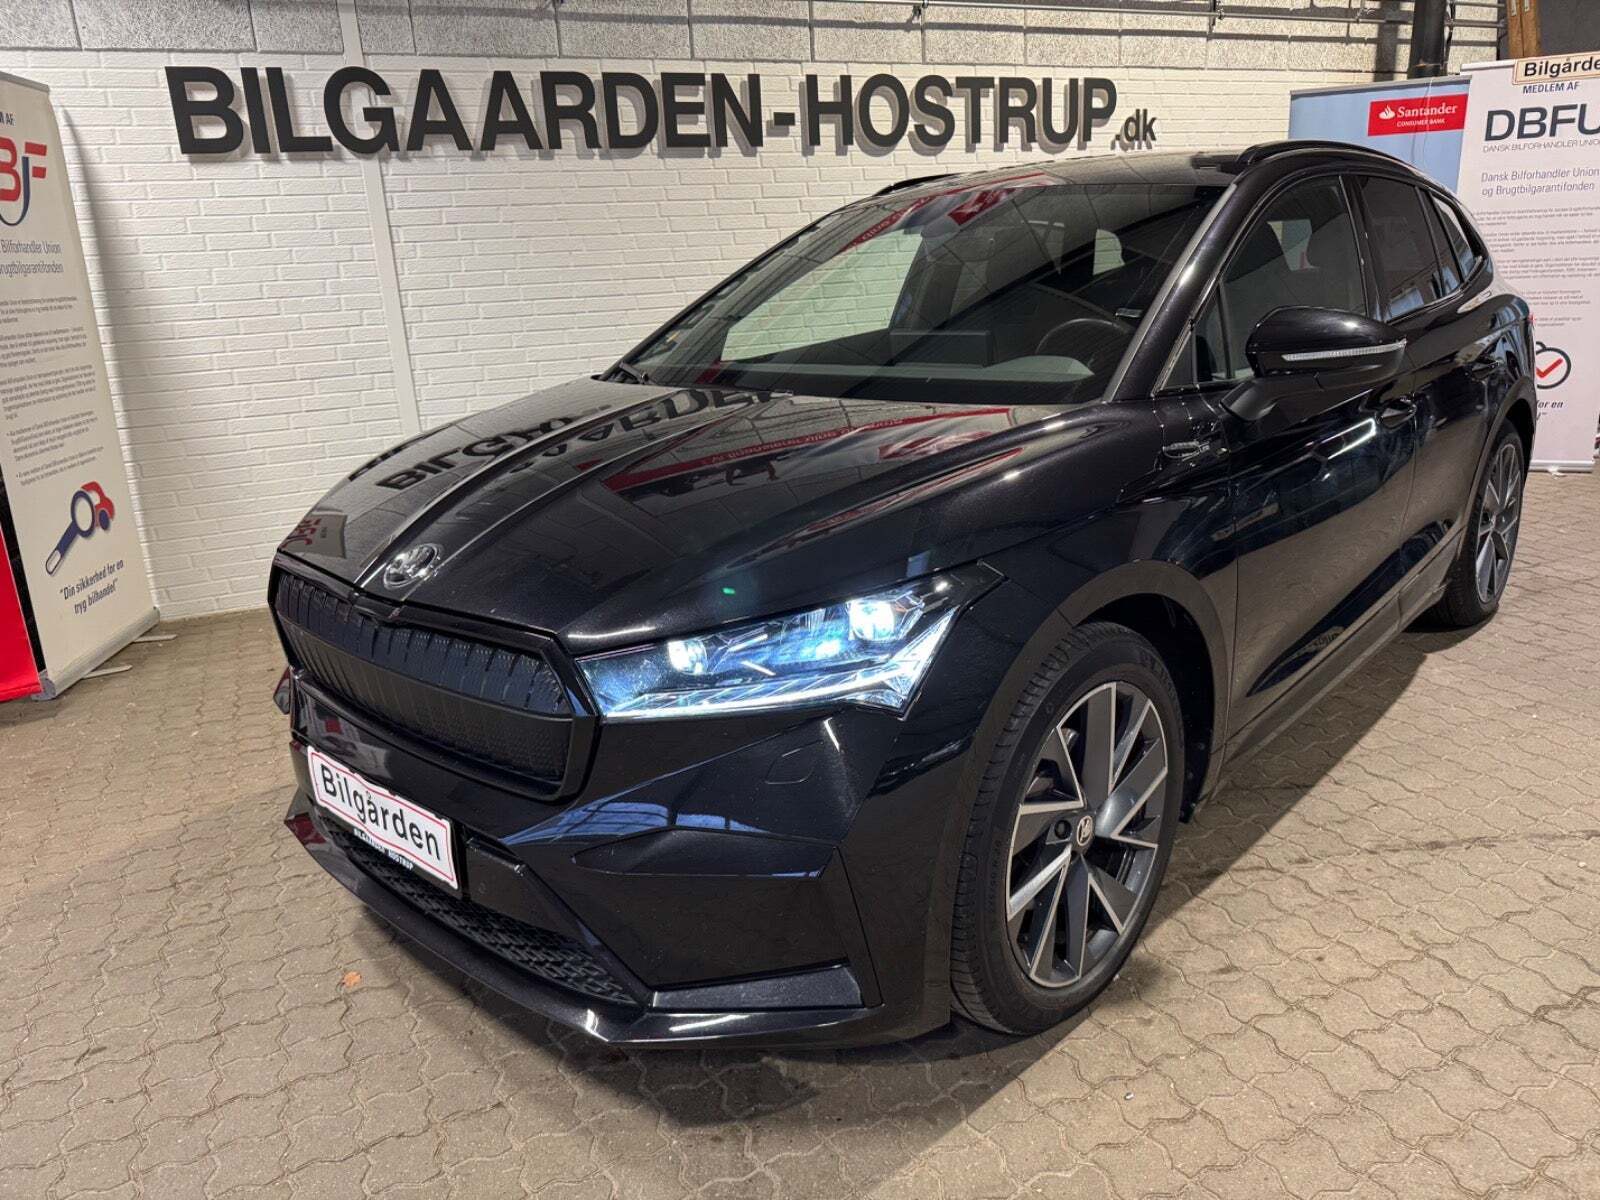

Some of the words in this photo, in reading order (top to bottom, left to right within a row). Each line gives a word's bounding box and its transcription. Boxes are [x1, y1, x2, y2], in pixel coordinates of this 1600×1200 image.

[1523, 83, 1566, 94] MEDLEM
[1567, 81, 1580, 92] AF
[1397, 102, 1458, 118] Santander
[1397, 119, 1428, 128] CONSUMER
[1429, 118, 1445, 126] BANK
[1485, 103, 1600, 141] DBFU
[1483, 143, 1511, 154] DANSK
[1512, 140, 1578, 152] BILFORHANDLER
[1481, 170, 1507, 182] Dansk
[1511, 168, 1571, 181] Bilforhandler
[1572, 167, 1600, 178] Union
[1482, 186, 1494, 197] og
[1496, 182, 1595, 196] Brugtbilgarantifonden
[1551, 401, 1564, 409] en
[76, 568, 106, 593] sikkerhed
[106, 563, 116, 575] for
[116, 560, 124, 570] en
[74, 598, 88, 615] tryg
[321, 763, 441, 861] Bilgården
